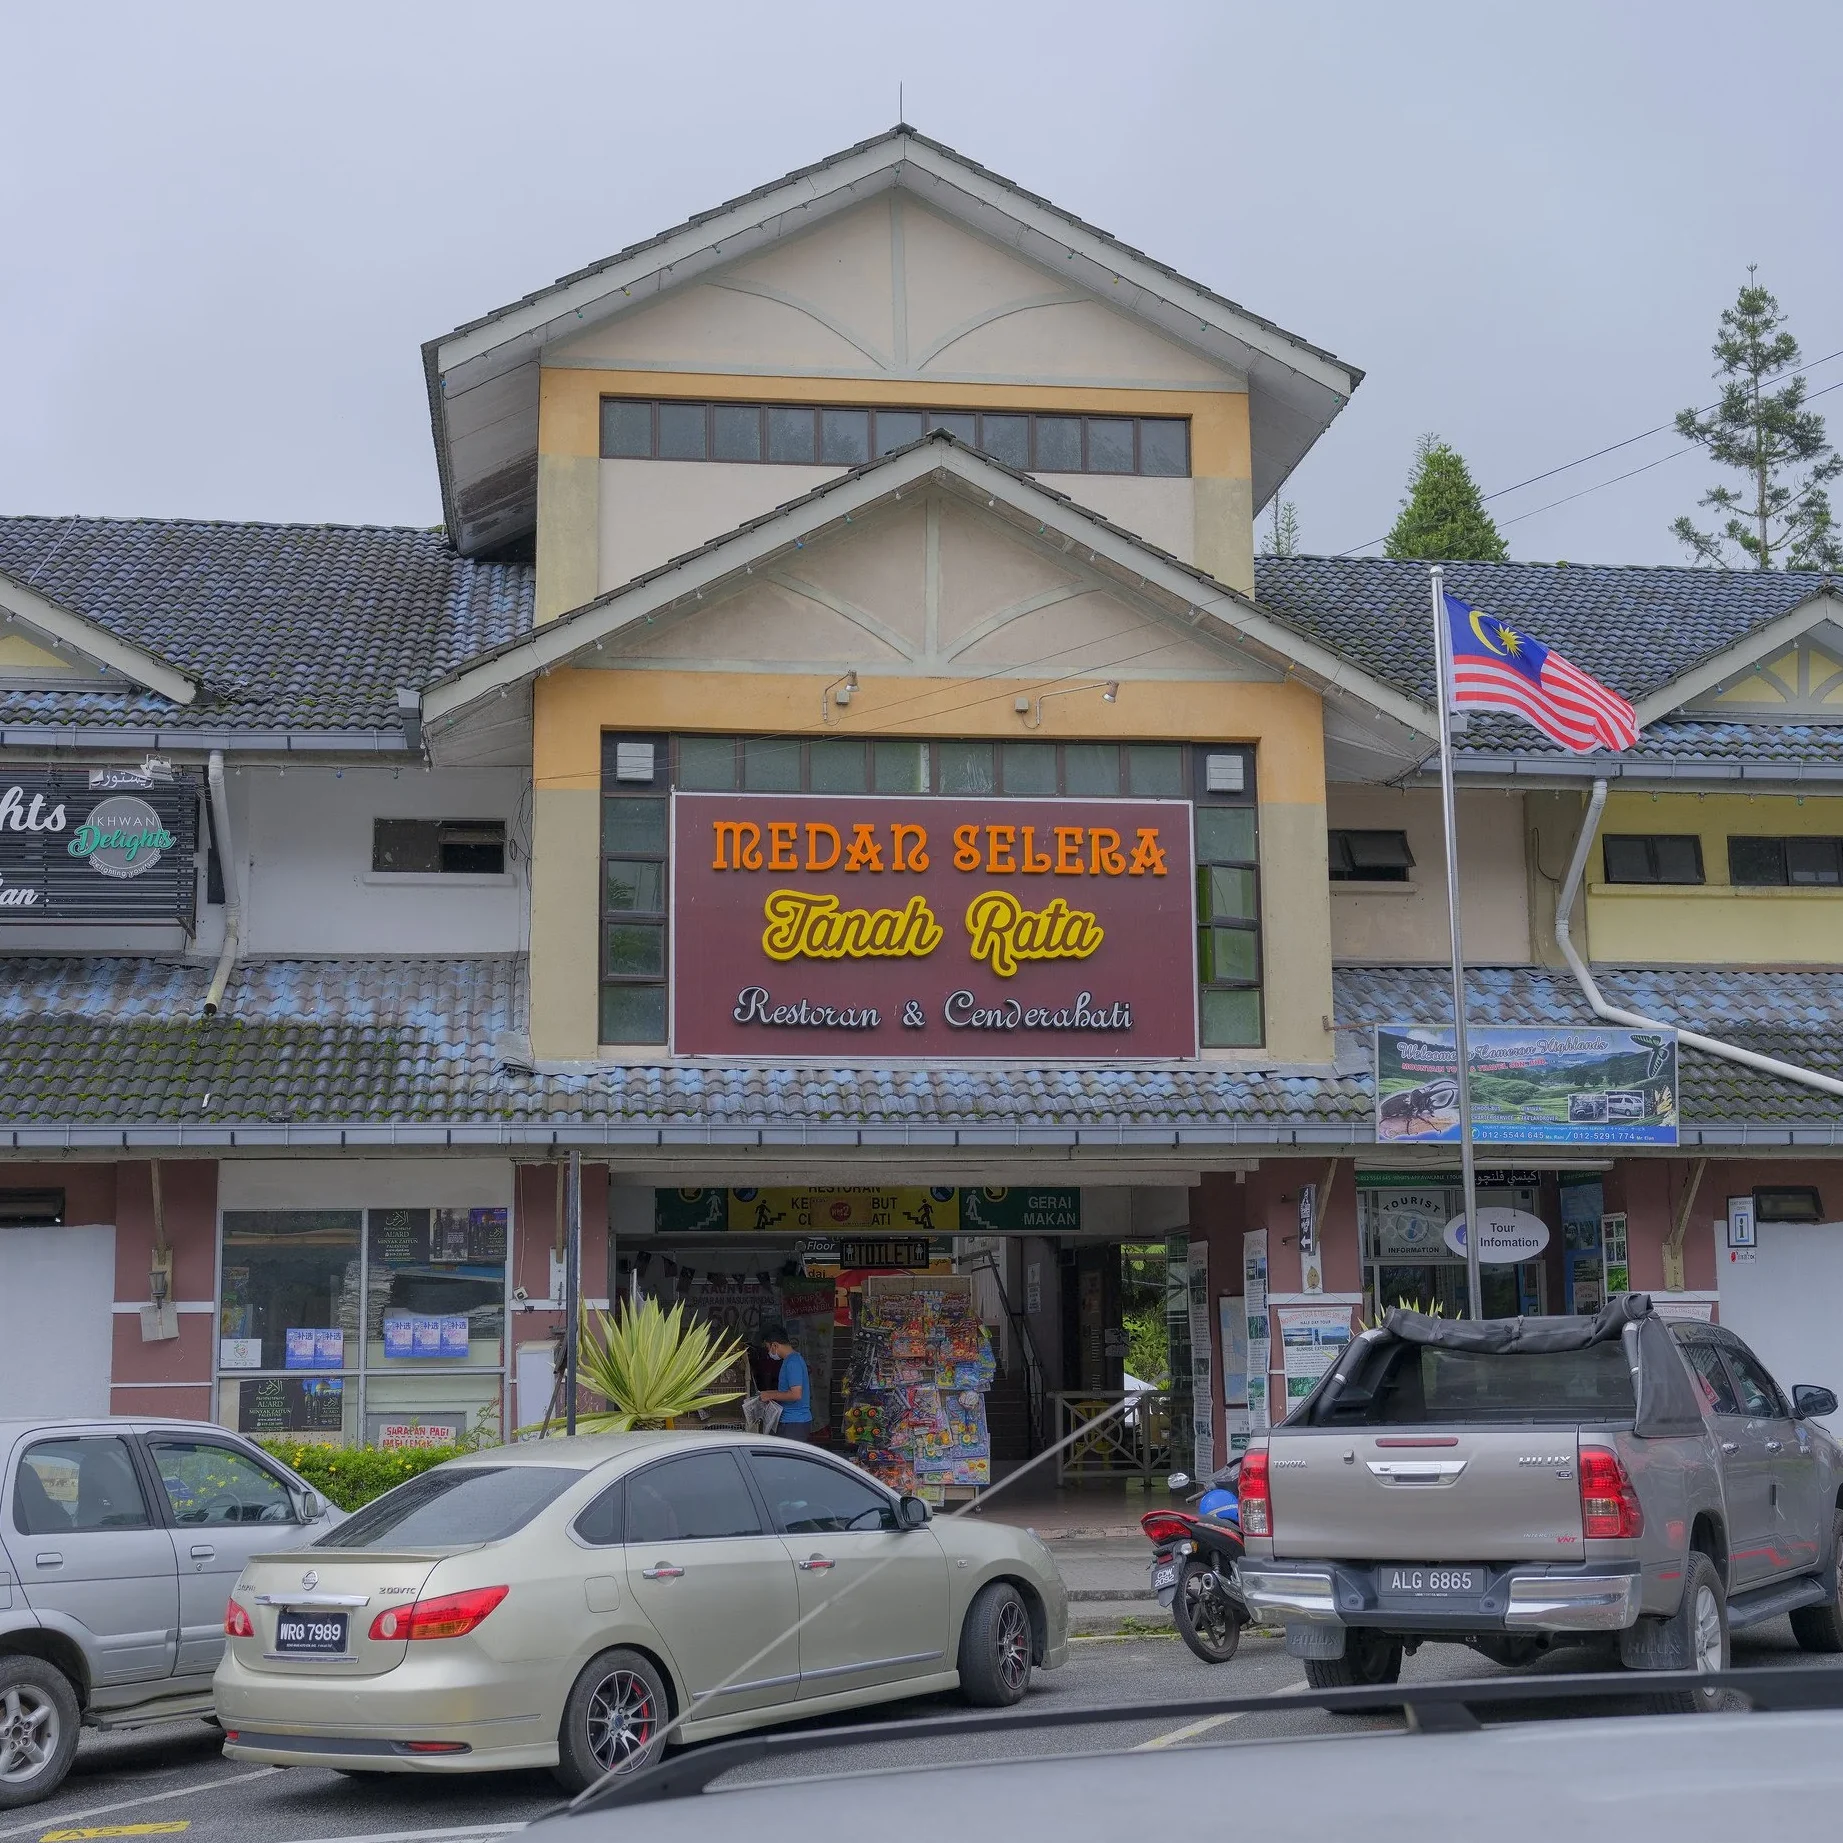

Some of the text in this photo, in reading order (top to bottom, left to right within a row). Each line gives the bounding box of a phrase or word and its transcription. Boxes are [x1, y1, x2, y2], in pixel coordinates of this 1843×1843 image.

[91, 816, 156, 828] IKHWAN
[68, 825, 177, 862] Delights
[712, 821, 1168, 876] MEDAN SELERA
[762, 889, 1104, 978] Tanah Rata
[732, 985, 1134, 1030] Restoran & Cenderahati
[1397, 1041, 1458, 1061] Welcome
[1475, 1044, 1537, 1060] Cameron
[1536, 1036, 1609, 1058] Highlands
[1401, 1063, 1446, 1072] MOUNTAIN
[1573, 1132, 1615, 1140] 012-5291
[1028, 1196, 1072, 1209] GERAI
[1383, 1196, 1441, 1213] TOURIST
[1024, 1212, 1076, 1226] MAKAN
[1490, 1222, 1516, 1233] Tour
[806, 1241, 836, 1251] Floor
[1480, 1237, 1539, 1247] Infomation
[858, 1243, 913, 1265] TOILET
[386, 1426, 449, 1437] SARAPAN PAGI
[1273, 1460, 1308, 1469] TOYOTA
[1519, 1455, 1571, 1467] HILUX
[1155, 1574, 1175, 1587] 2092
[1391, 1571, 1472, 1590] ALG 6865
[307, 1623, 341, 1641] 7989
